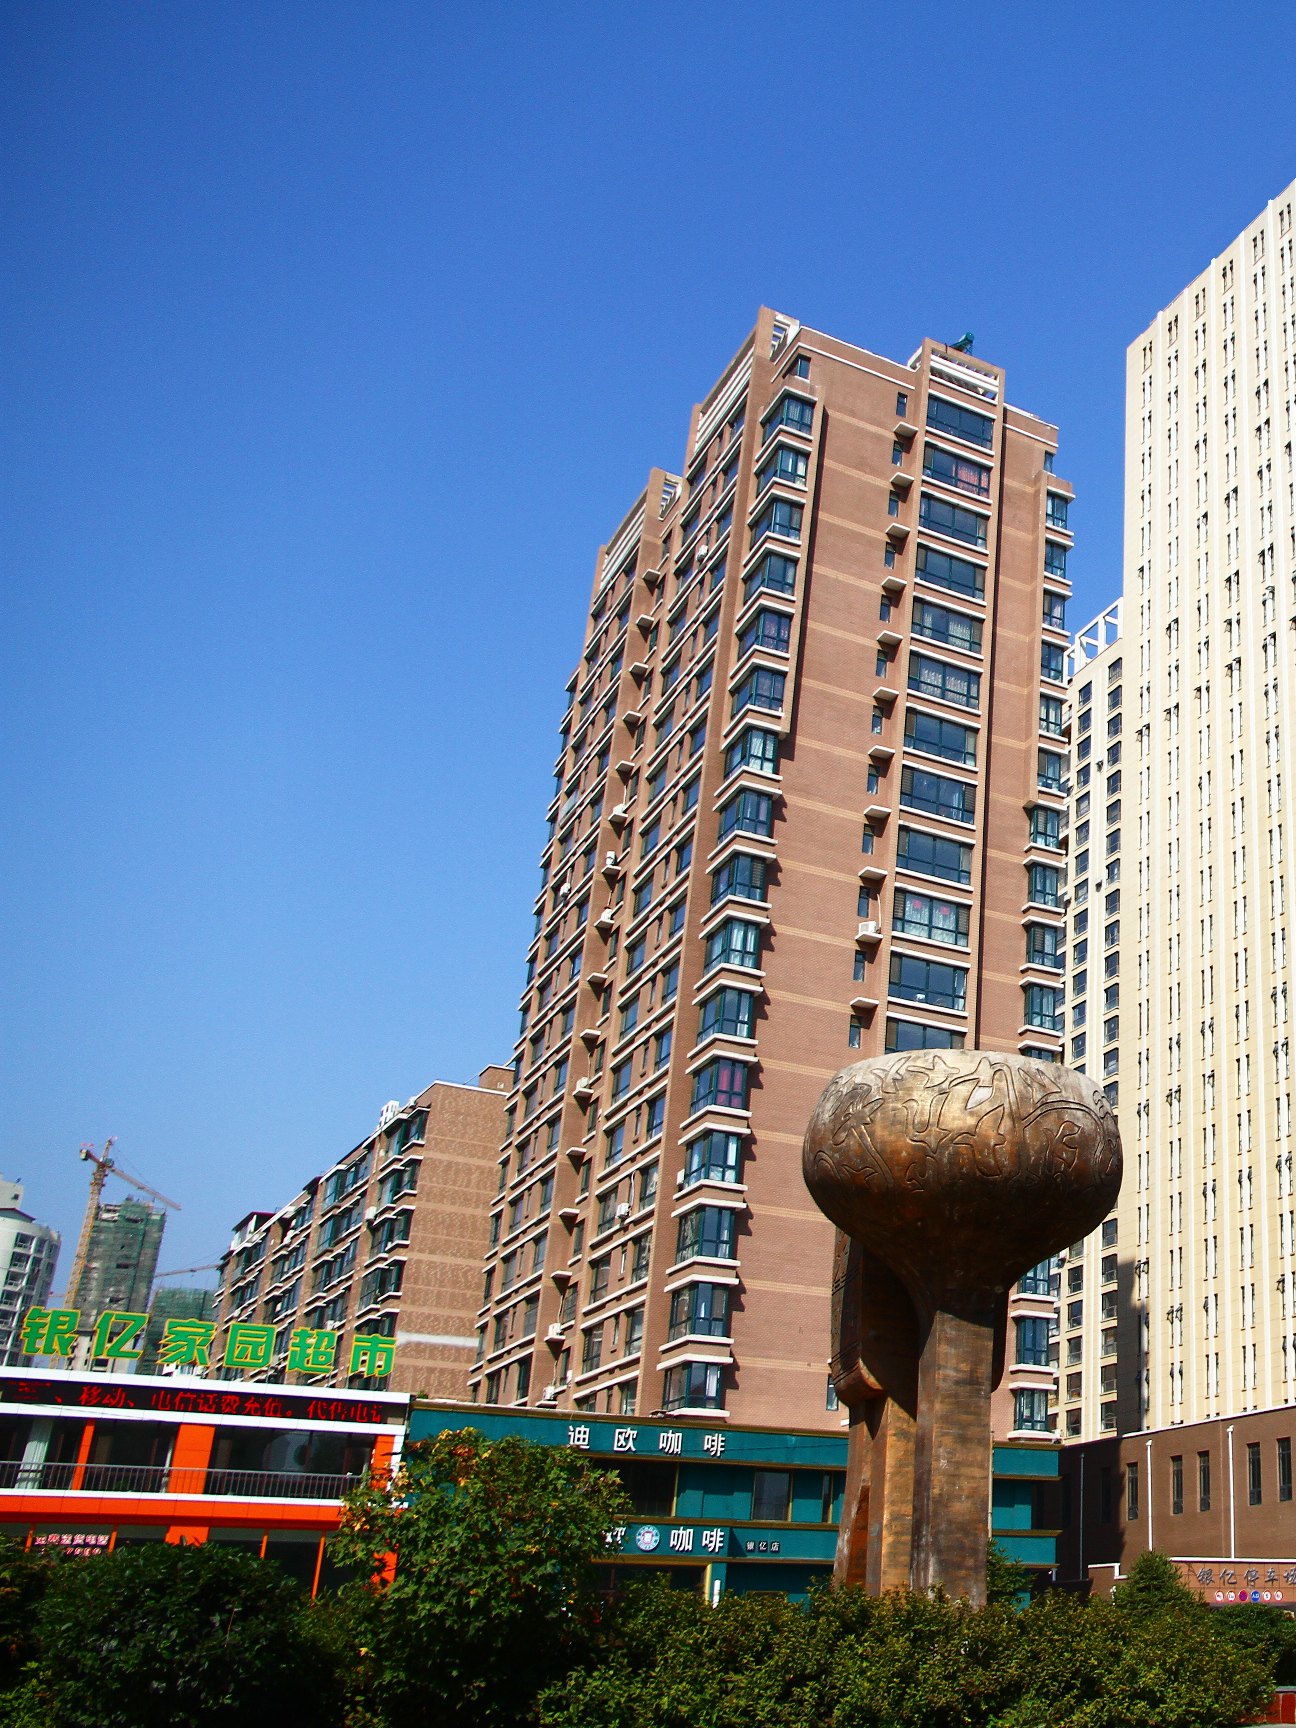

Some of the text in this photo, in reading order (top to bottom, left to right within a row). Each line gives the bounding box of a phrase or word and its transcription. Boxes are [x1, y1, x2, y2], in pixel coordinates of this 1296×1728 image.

[20, 1306, 398, 1377] 银亿家园超市
[568, 1425, 726, 1457] 迪欧咖啡
[746, 1541, 780, 1551] 银亿店
